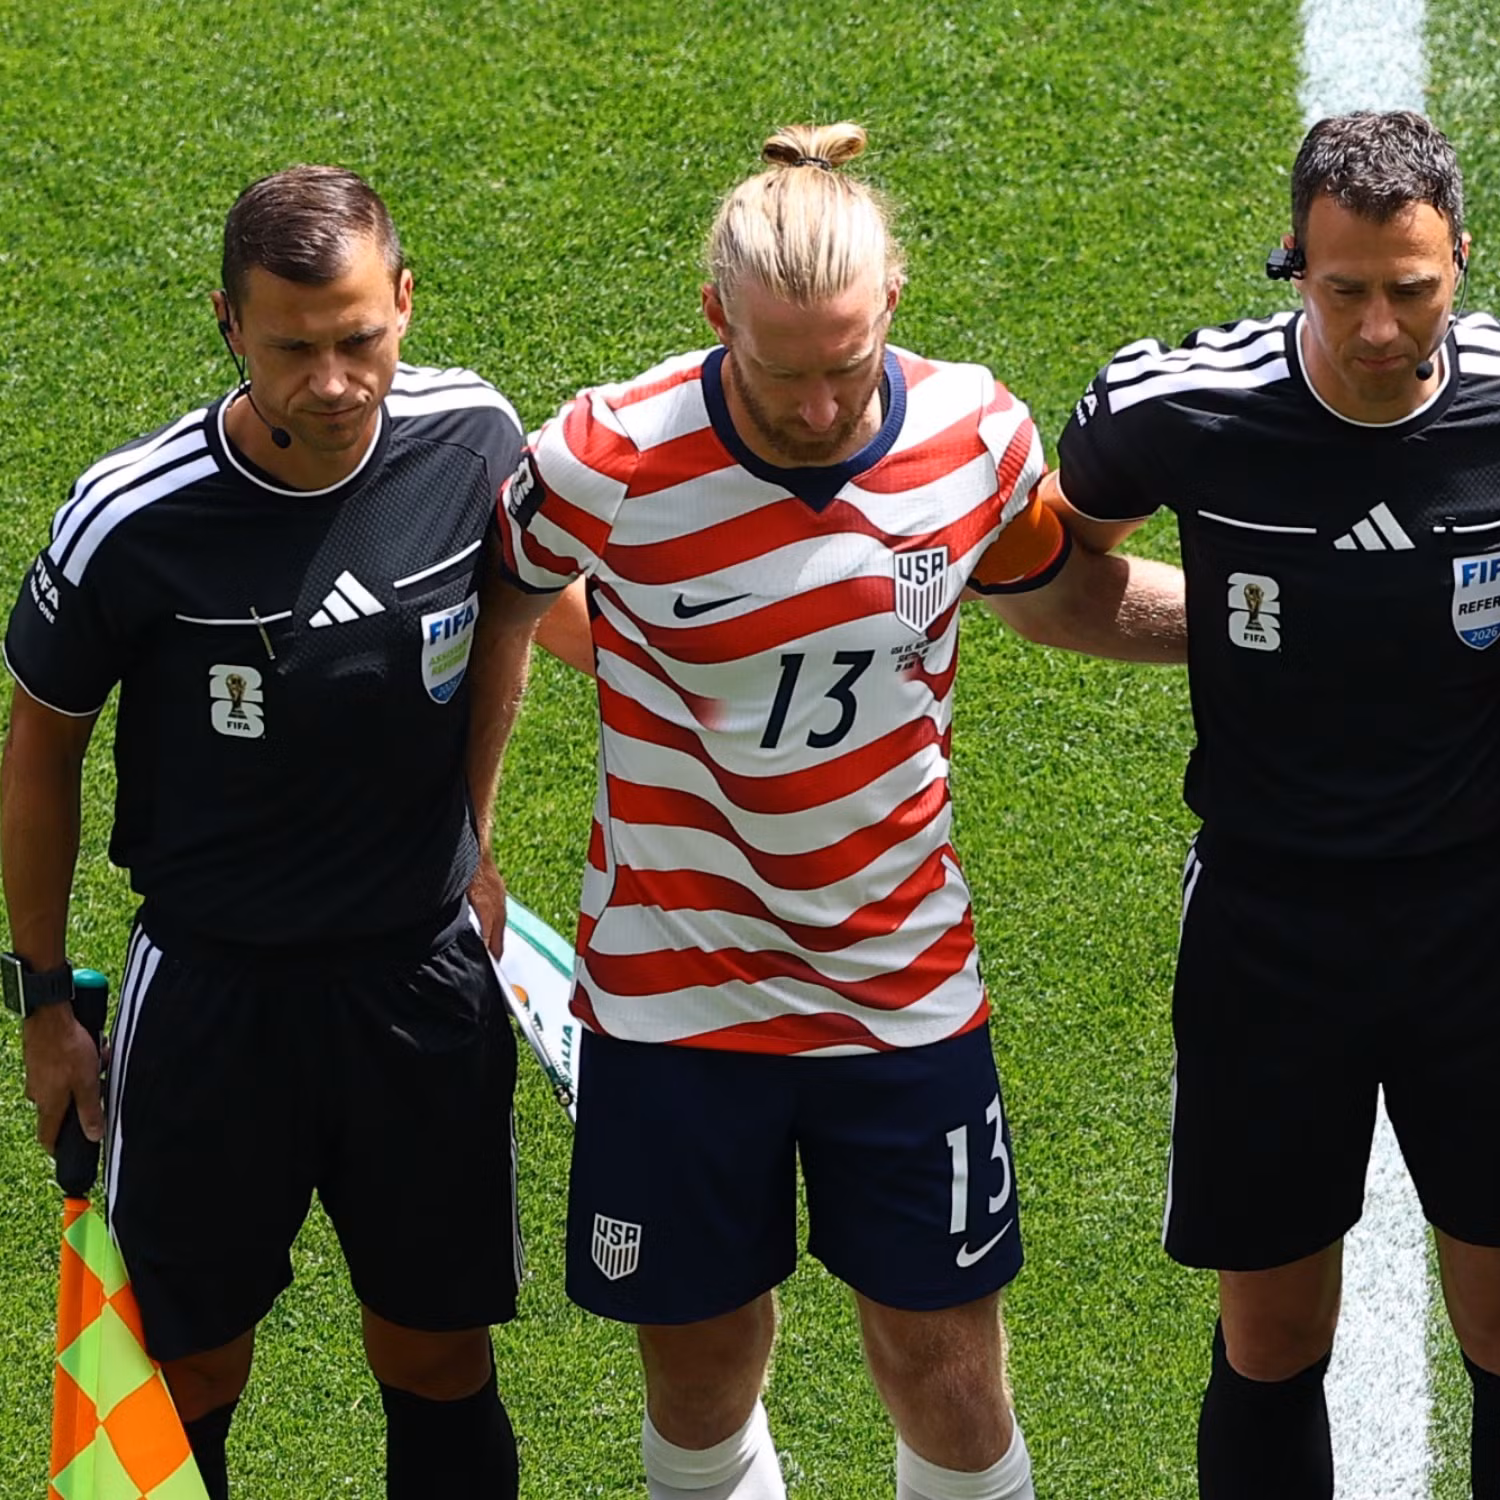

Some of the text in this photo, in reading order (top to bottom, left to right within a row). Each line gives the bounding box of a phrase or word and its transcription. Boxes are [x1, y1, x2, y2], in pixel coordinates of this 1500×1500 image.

[35, 554, 59, 611] FIFA
[899, 551, 944, 586] USA
[429, 604, 475, 646] FIFA
[1243, 632, 1267, 644] FIFA
[1471, 626, 1499, 642] 2026
[760, 649, 876, 749] 13
[226, 720, 251, 731] FIFA
[945, 1092, 1011, 1234] 13
[597, 1217, 639, 1246] USA
